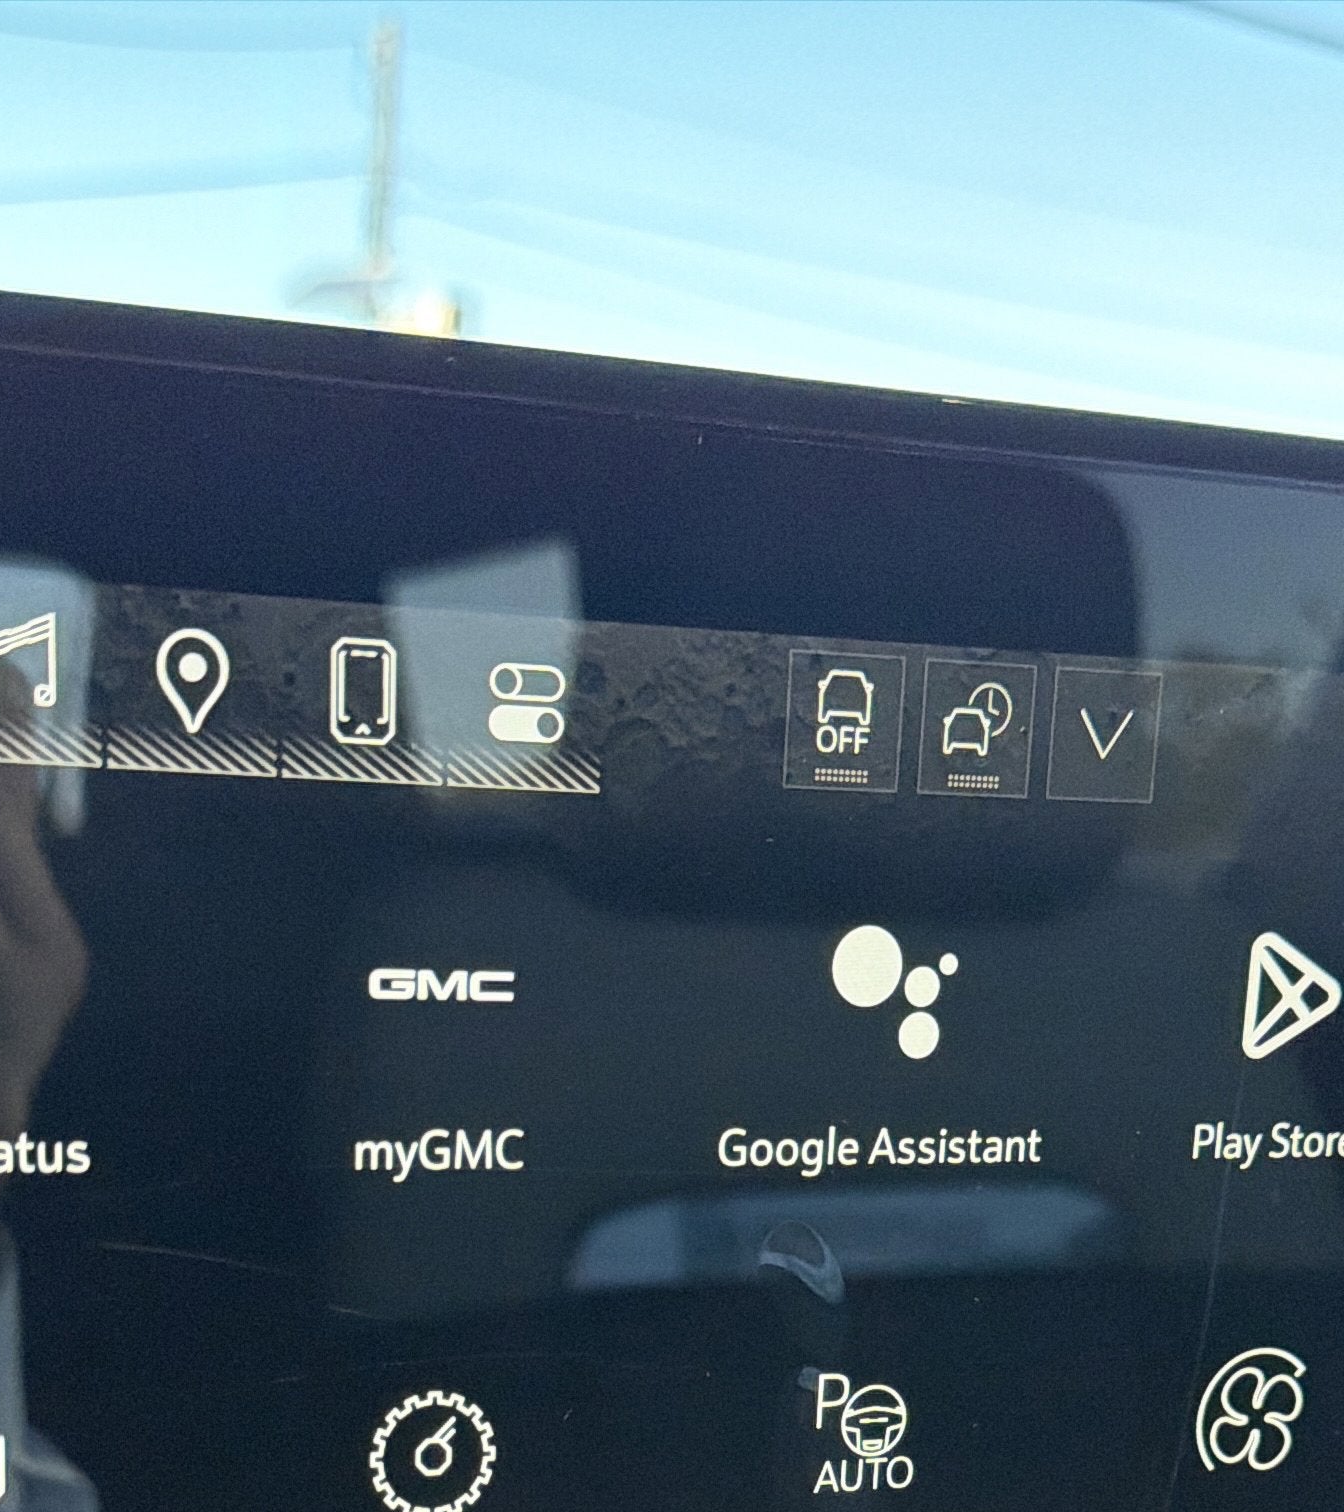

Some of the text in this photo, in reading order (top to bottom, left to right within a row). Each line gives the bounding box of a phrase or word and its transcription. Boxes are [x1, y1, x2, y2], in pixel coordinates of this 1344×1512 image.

[815, 724, 871, 755] OFF
[368, 967, 515, 1002] GMC
[354, 1128, 525, 1183] myGMC
[717, 1125, 1042, 1178] Google Assistant
[1192, 1121, 1262, 1170] Play
[813, 1454, 915, 1494] AUTO
